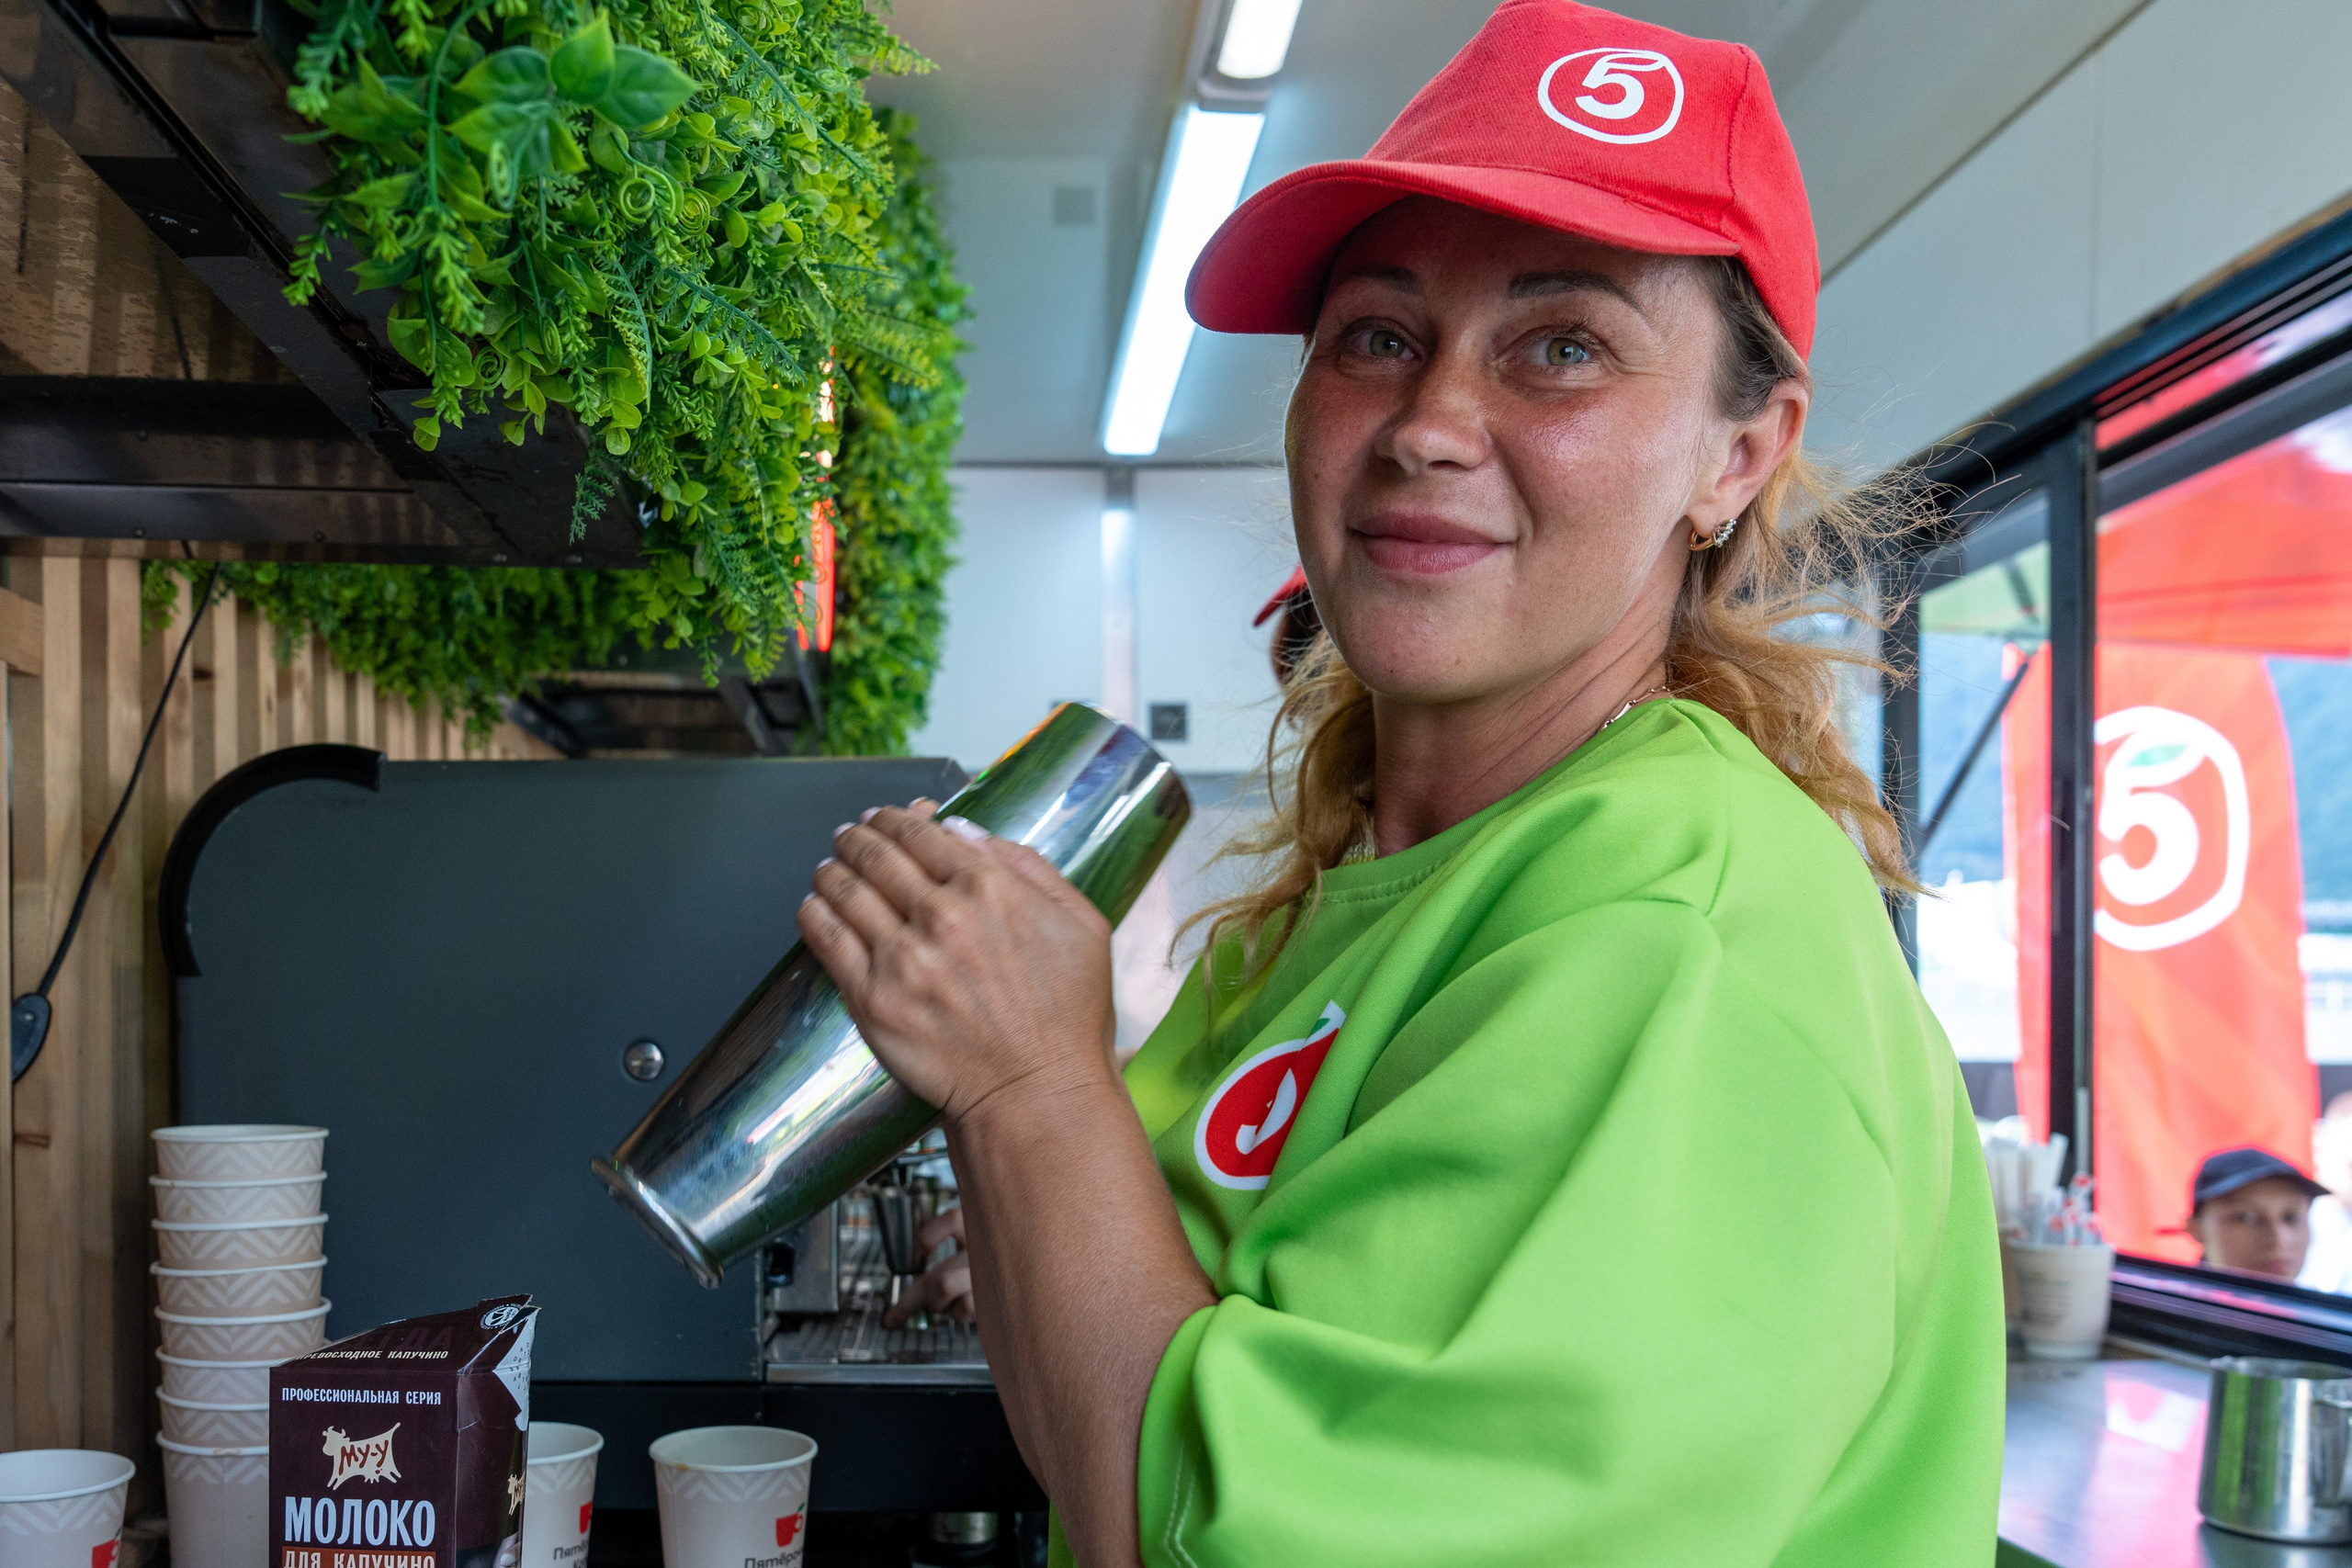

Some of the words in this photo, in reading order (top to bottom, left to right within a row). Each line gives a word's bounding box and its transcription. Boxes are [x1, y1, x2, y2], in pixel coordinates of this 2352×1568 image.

[1575, 52, 1659, 119] 5
[2098, 731, 2205, 906] 5
[387, 1350, 449, 1360] КАПУЧИНО
[281, 1387, 400, 1404] ПРОФЕССИОНАЛЬНАЯ
[405, 1391, 442, 1405] СЕРИЯ
[284, 1495, 436, 1548] МОЛОКО
[283, 1550, 322, 1568] ДЛЯ
[333, 1552, 435, 1568] КАПУЧИНО
